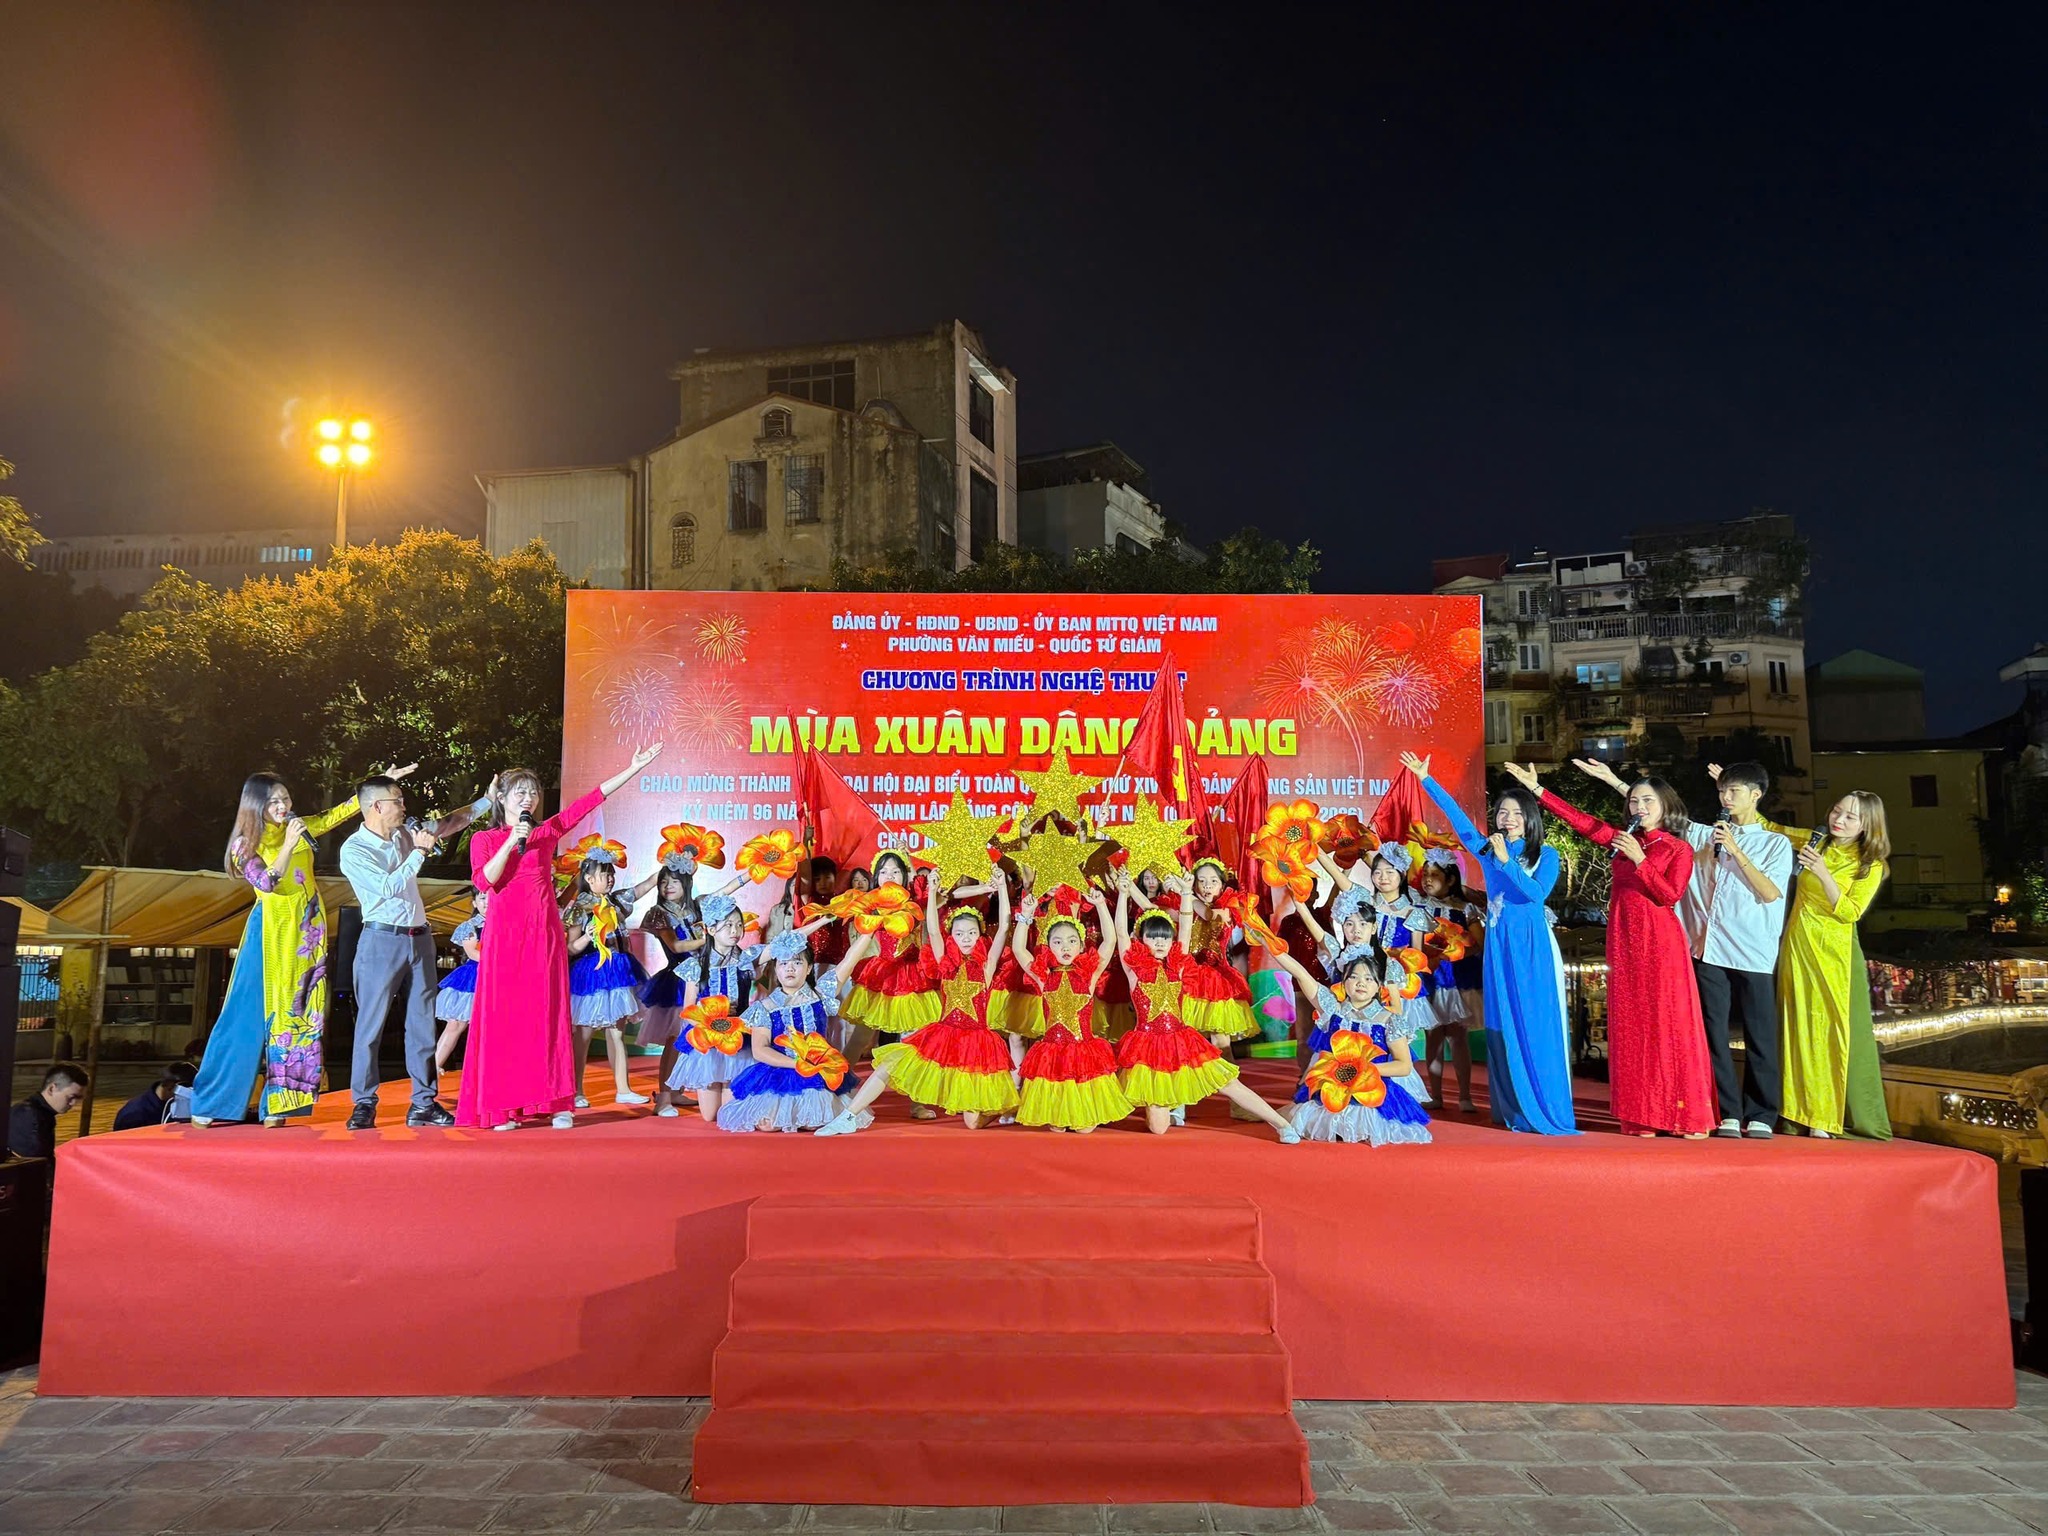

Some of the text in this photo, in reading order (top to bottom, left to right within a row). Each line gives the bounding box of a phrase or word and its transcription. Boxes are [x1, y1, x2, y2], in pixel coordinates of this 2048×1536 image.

[832, 611, 876, 630] ĐẢNG
[880, 611, 901, 630] ỦY
[916, 616, 960, 630] HĐND
[975, 616, 1019, 631] UBND
[1034, 612, 1055, 631] ỦY
[1058, 617, 1092, 631] BAN
[1096, 617, 1139, 633] MTTQ
[1142, 615, 1176, 634] VIỆT
[1180, 617, 1217, 631] NAM
[888, 634, 953, 652] PHƯỜNG
[957, 635, 989, 652] VĂN
[994, 633, 1034, 653] MIẾU
[1049, 634, 1092, 654] QUỐC
[1096, 634, 1117, 653] TỬ
[1119, 634, 1162, 653] GIÁM
[861, 667, 1187, 695] CHƯƠNG TRÌNH NGHỆ THUT
[750, 708, 860, 753] MÙA
[874, 709, 1006, 754] XUÂN
[639, 772, 682, 793] CHÀO
[687, 772, 735, 793] MỪNG
[739, 772, 791, 793] THÀNH
[873, 772, 900, 795] HỘI
[903, 775, 931, 796] ĐẠI
[934, 769, 970, 793] BIỂU
[975, 773, 1015, 794] TOÀN
[1134, 777, 1158, 794] XIV
[1294, 773, 1327, 795] SẢN
[1331, 775, 1365, 799] VIỆT
[1369, 779, 1394, 796] NA
[707, 800, 749, 824] NIỆM
[753, 804, 773, 821] 96
[777, 801, 798, 821] NĂ
[869, 800, 916, 821] HÀNH
